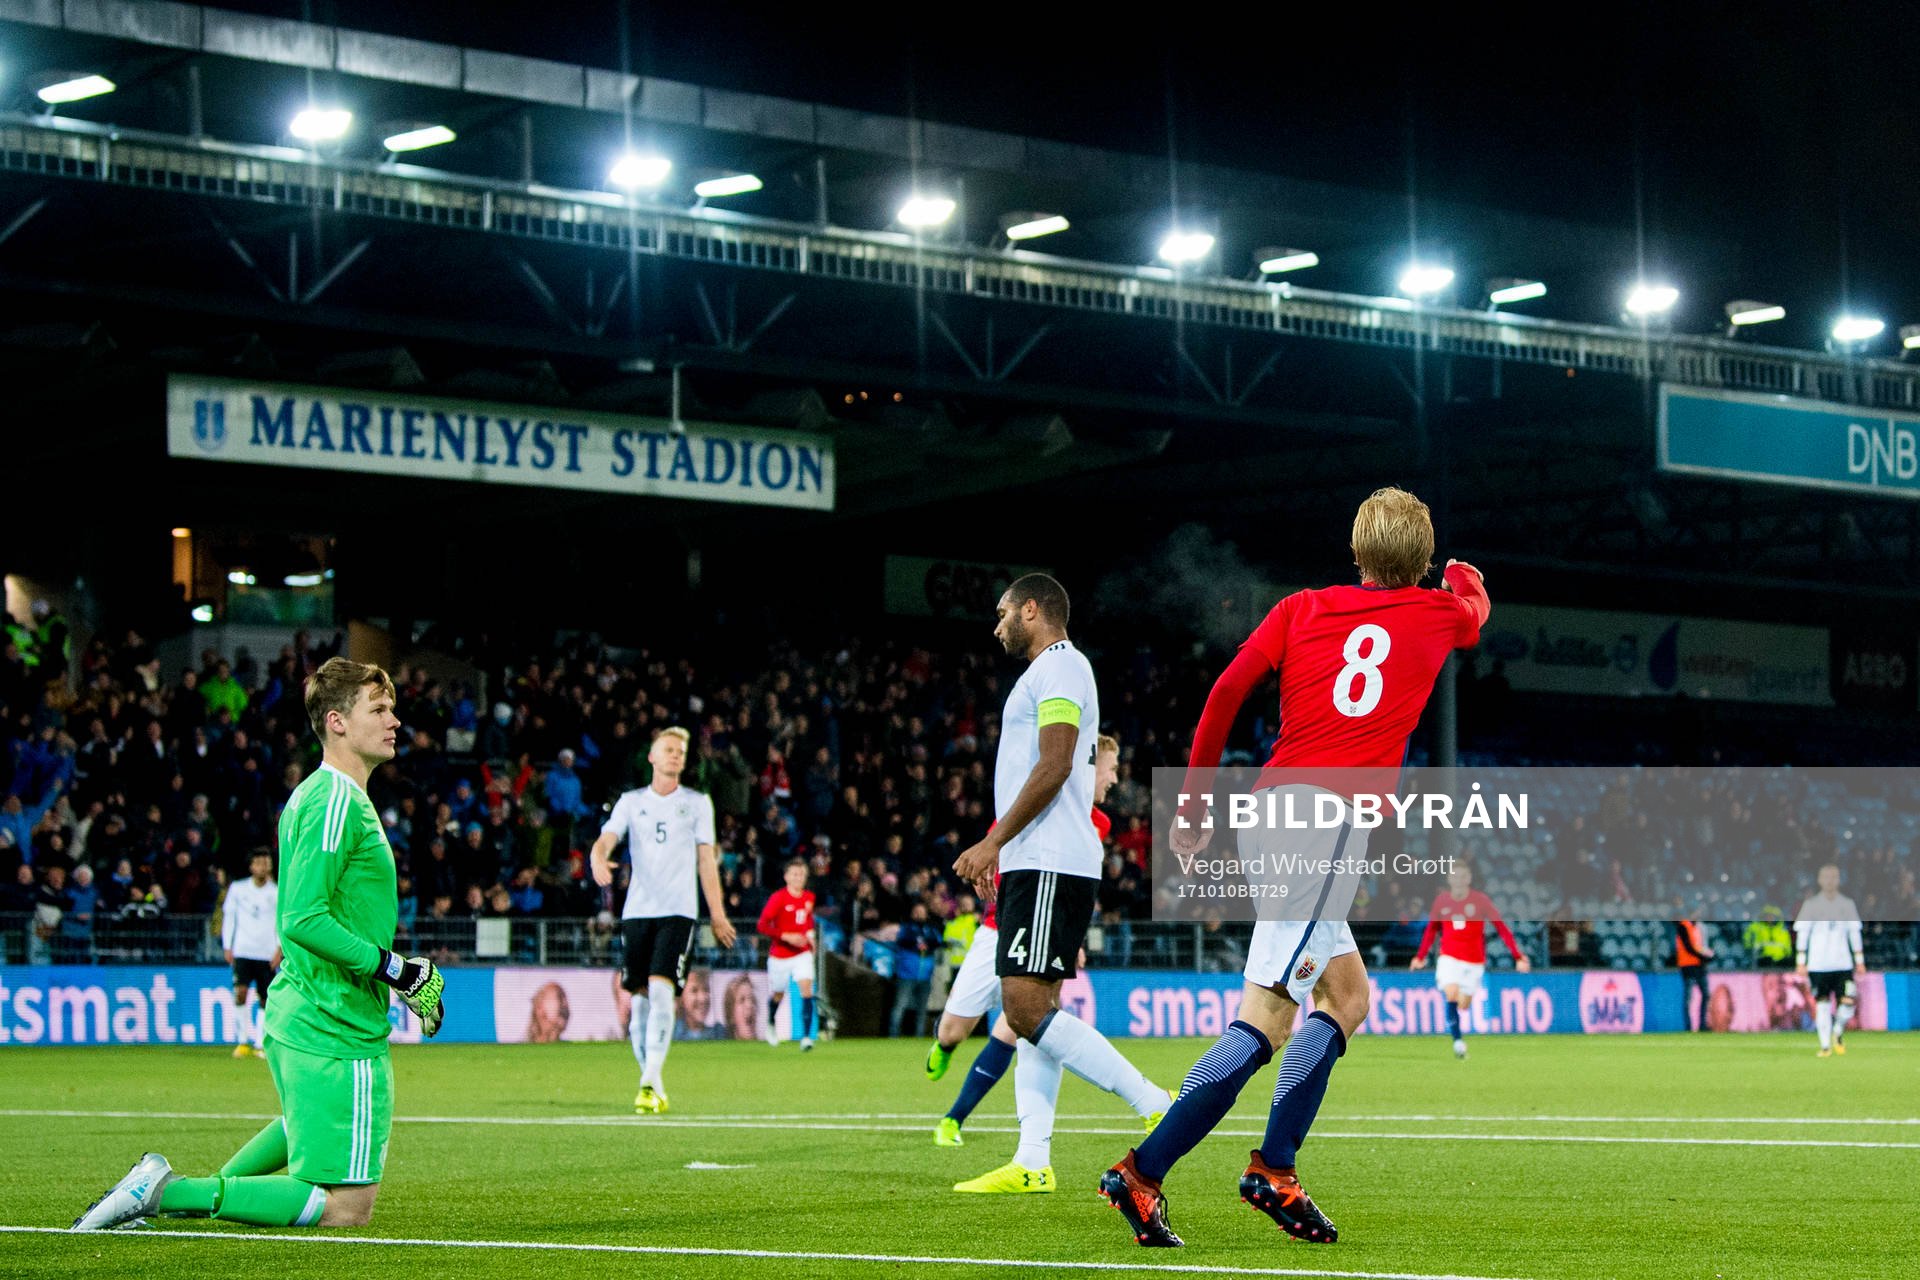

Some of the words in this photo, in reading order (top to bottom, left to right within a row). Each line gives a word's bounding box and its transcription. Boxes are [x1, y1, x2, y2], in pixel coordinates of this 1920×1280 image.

[249, 395, 588, 472] MARIENLYST
[611, 429, 824, 493] STADION
[1847, 418, 1918, 485] DNB
[1332, 623, 1392, 718] 8
[655, 821, 668, 844] 5
[1007, 927, 1028, 966] 4
[1132, 1190, 1150, 1223] adidas
